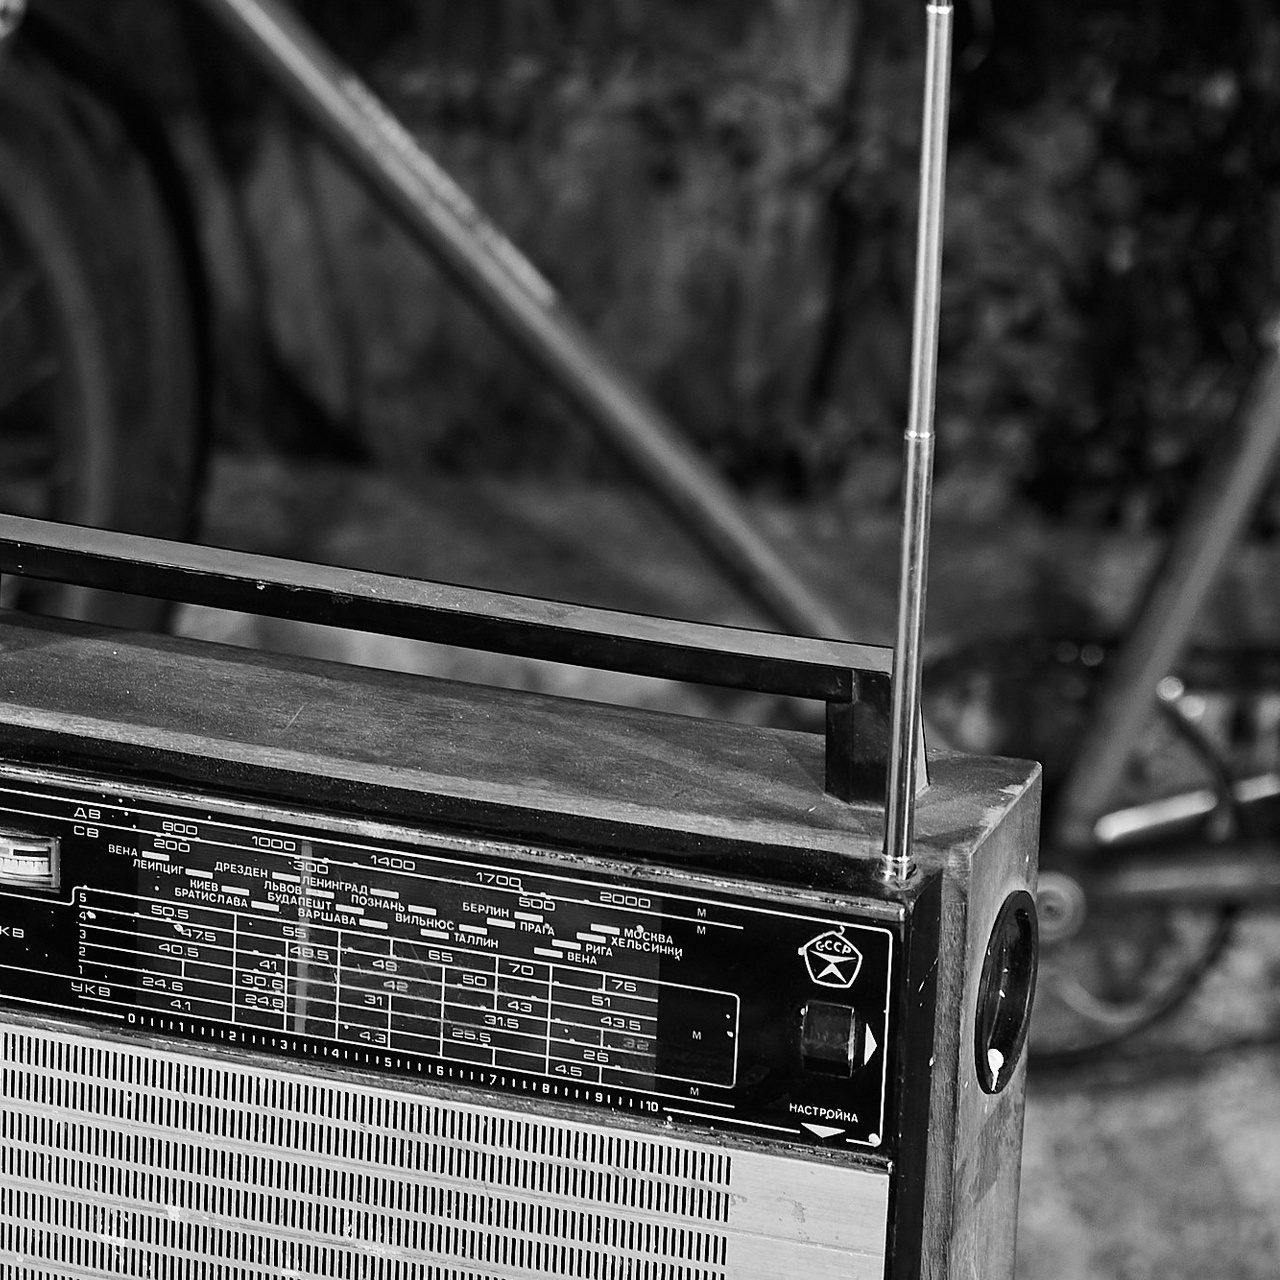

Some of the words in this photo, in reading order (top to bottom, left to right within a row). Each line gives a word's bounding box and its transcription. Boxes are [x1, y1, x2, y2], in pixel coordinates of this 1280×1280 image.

[73, 807, 101, 820] ДВ
[162, 821, 198, 836] 800
[252, 836, 296, 852] 1000
[370, 854, 415, 871] 1400
[476, 872, 521, 888] 1700
[600, 891, 651, 909] 2000
[108, 844, 138, 857] ВЕНА
[73, 825, 99, 838] СВ
[153, 838, 190, 853] 200
[293, 860, 329, 875] 300
[519, 896, 556, 911] 500
[214, 861, 268, 879] ДРЕЗДЕН
[190, 879, 219, 892] КИЕВ
[264, 880, 302, 895] ЛЬВОВ
[302, 875, 369, 896] ЛЕНИНГРАД
[174, 887, 248, 908] БРАТИСЛАВА
[267, 892, 332, 911] БУДАПЕШТ
[351, 894, 406, 912] ПОЗНАНЬ
[298, 907, 357, 926] ВАРШАВА
[462, 902, 509, 918] БЕРЛИН
[395, 913, 455, 931] ВИЛЬНЮС
[520, 922, 555, 936] ПРАГА
[0, 925, 25, 939] КВ
[454, 932, 499, 949] ТАЛЛИН
[624, 928, 673, 945] МОСКВА
[79, 893, 87, 903] 5
[151, 904, 189, 919] 50.5
[282, 926, 307, 939] 55
[428, 950, 453, 963] 65
[508, 963, 534, 976] 70
[611, 979, 637, 992] 76
[585, 943, 613, 957] РИГА
[611, 936, 683, 957] ХЕЛЬСИНКИ
[815, 940, 852, 954] СССР
[79, 911, 86, 921] 4
[181, 927, 217, 942] 47.5
[290, 946, 329, 961] 48.5
[372, 959, 397, 972] 49
[462, 974, 487, 987] 50
[591, 995, 611, 1007] 51
[567, 951, 598, 965] ВЕНА
[79, 929, 86, 939] 3
[158, 943, 199, 958] 40.5
[259, 960, 277, 971] 41
[383, 980, 409, 993] 42
[507, 1000, 533, 1013] 43
[600, 1016, 641, 1031] 43.5
[78, 947, 86, 957] 2
[241, 974, 284, 990] 30.6
[364, 994, 383, 1006] 31
[484, 1014, 519, 1029] 31.5
[623, 1037, 649, 1051] 32
[142, 976, 184, 992] 24.6
[245, 993, 284, 1009] 24.8
[452, 1028, 491, 1043] 25.5
[583, 1049, 609, 1063] 26
[71, 982, 111, 997] УКВ
[170, 999, 191, 1011] 4.1
[359, 1031, 386, 1044] 4.3
[555, 1064, 583, 1077] 4.5
[127, 1013, 136, 1023] 0
[229, 1030, 237, 1041] 2
[280, 1040, 288, 1050] 3
[331, 1048, 340, 1058] 4
[384, 1057, 392, 1068] 5
[436, 1065, 444, 1076] 6
[489, 1074, 497, 1085] 7
[542, 1083, 550, 1094] 8
[595, 1092, 603, 1102] 9
[646, 1100, 659, 1112] 10
[789, 1102, 859, 1123] НАСТРОЙКА
